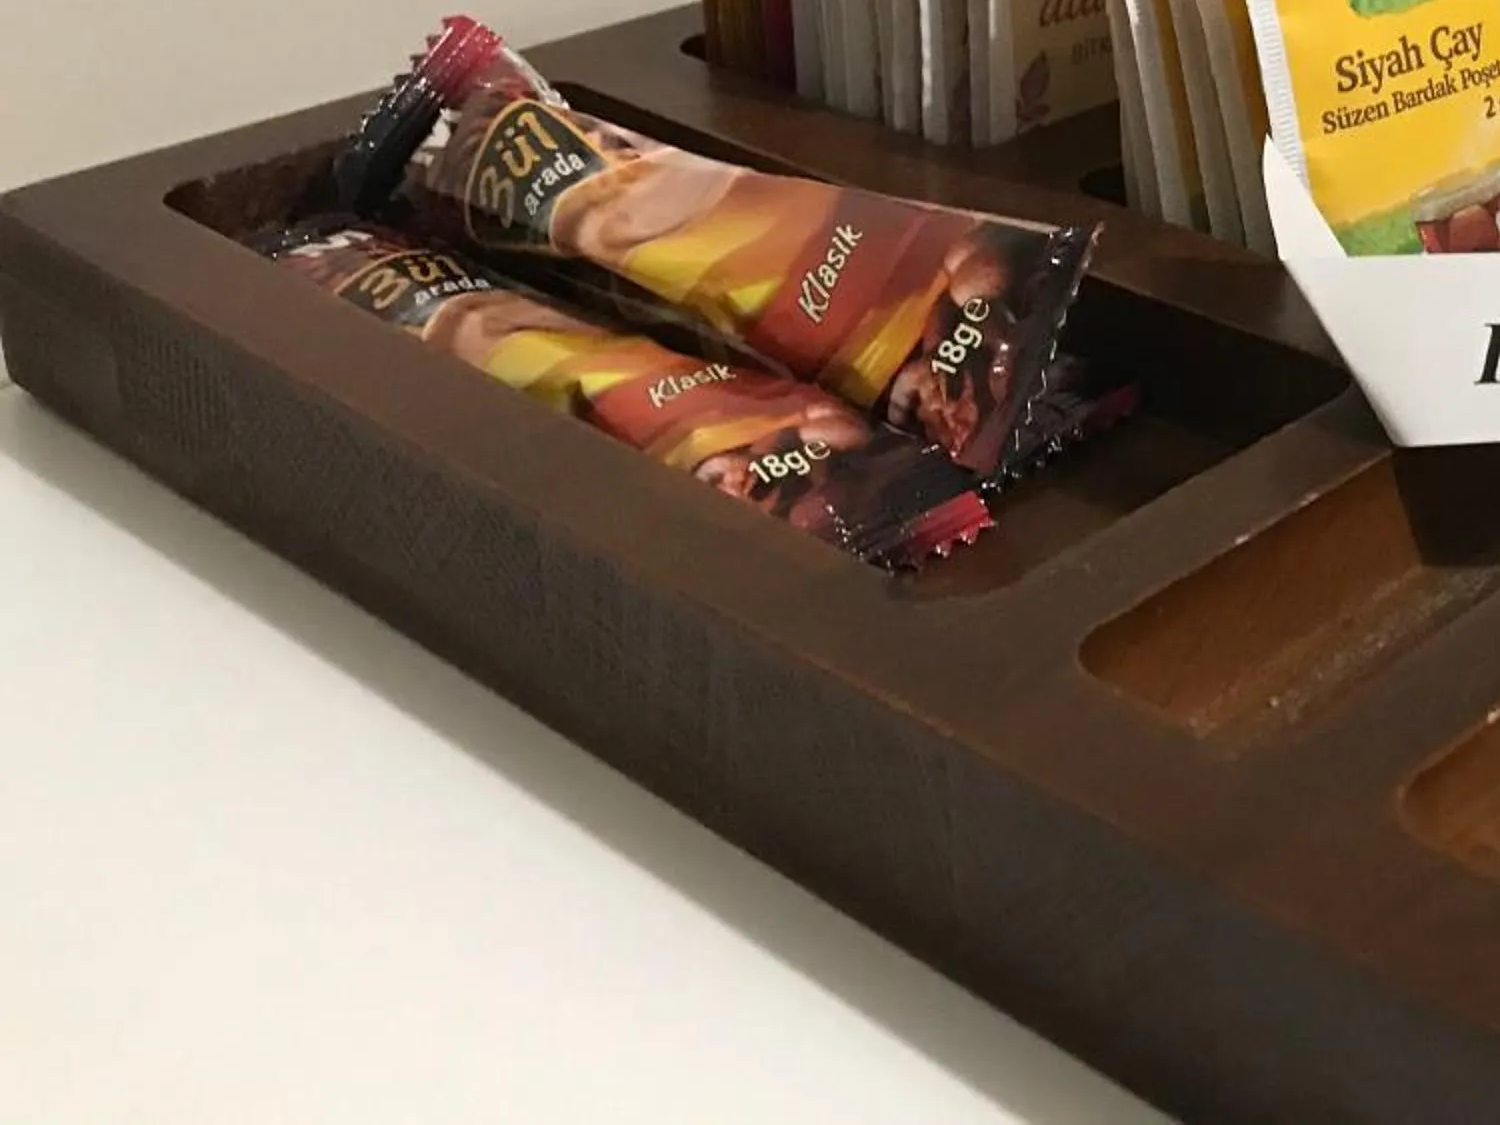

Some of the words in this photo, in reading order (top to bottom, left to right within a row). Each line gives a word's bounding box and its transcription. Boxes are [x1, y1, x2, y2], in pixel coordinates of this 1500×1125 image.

[1334, 36, 1425, 94] Siyah
[1429, 22, 1485, 72] Çay
[1321, 97, 1391, 135] Süzen
[1392, 72, 1459, 115] Bardak
[1484, 95, 1496, 120] 2
[523, 151, 587, 217] arada
[412, 276, 493, 306] arada
[797, 223, 864, 325] Klasik
[647, 361, 738, 410] Klasik
